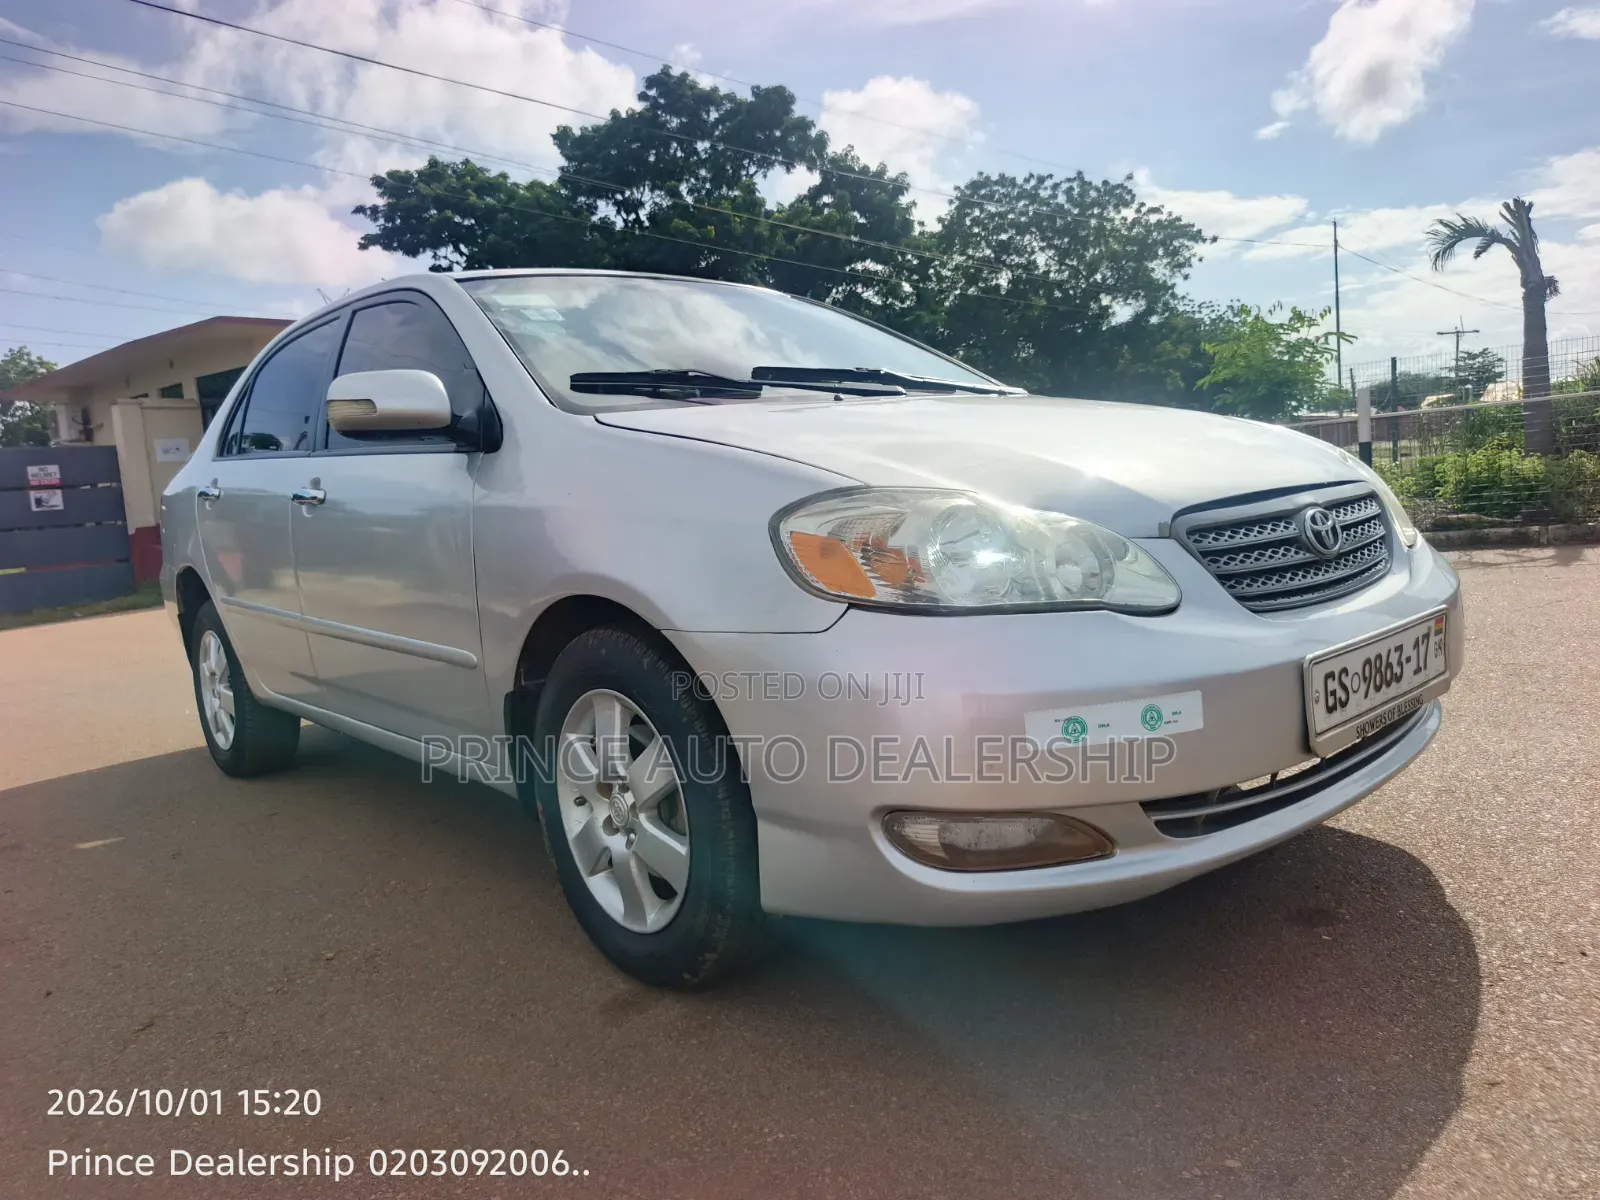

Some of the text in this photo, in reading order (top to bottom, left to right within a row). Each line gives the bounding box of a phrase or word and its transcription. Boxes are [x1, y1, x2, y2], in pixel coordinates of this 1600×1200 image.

[1323, 666, 1350, 714] GS
[1355, 712, 1388, 739] SHOWERS
[1387, 705, 1397, 722] OF
